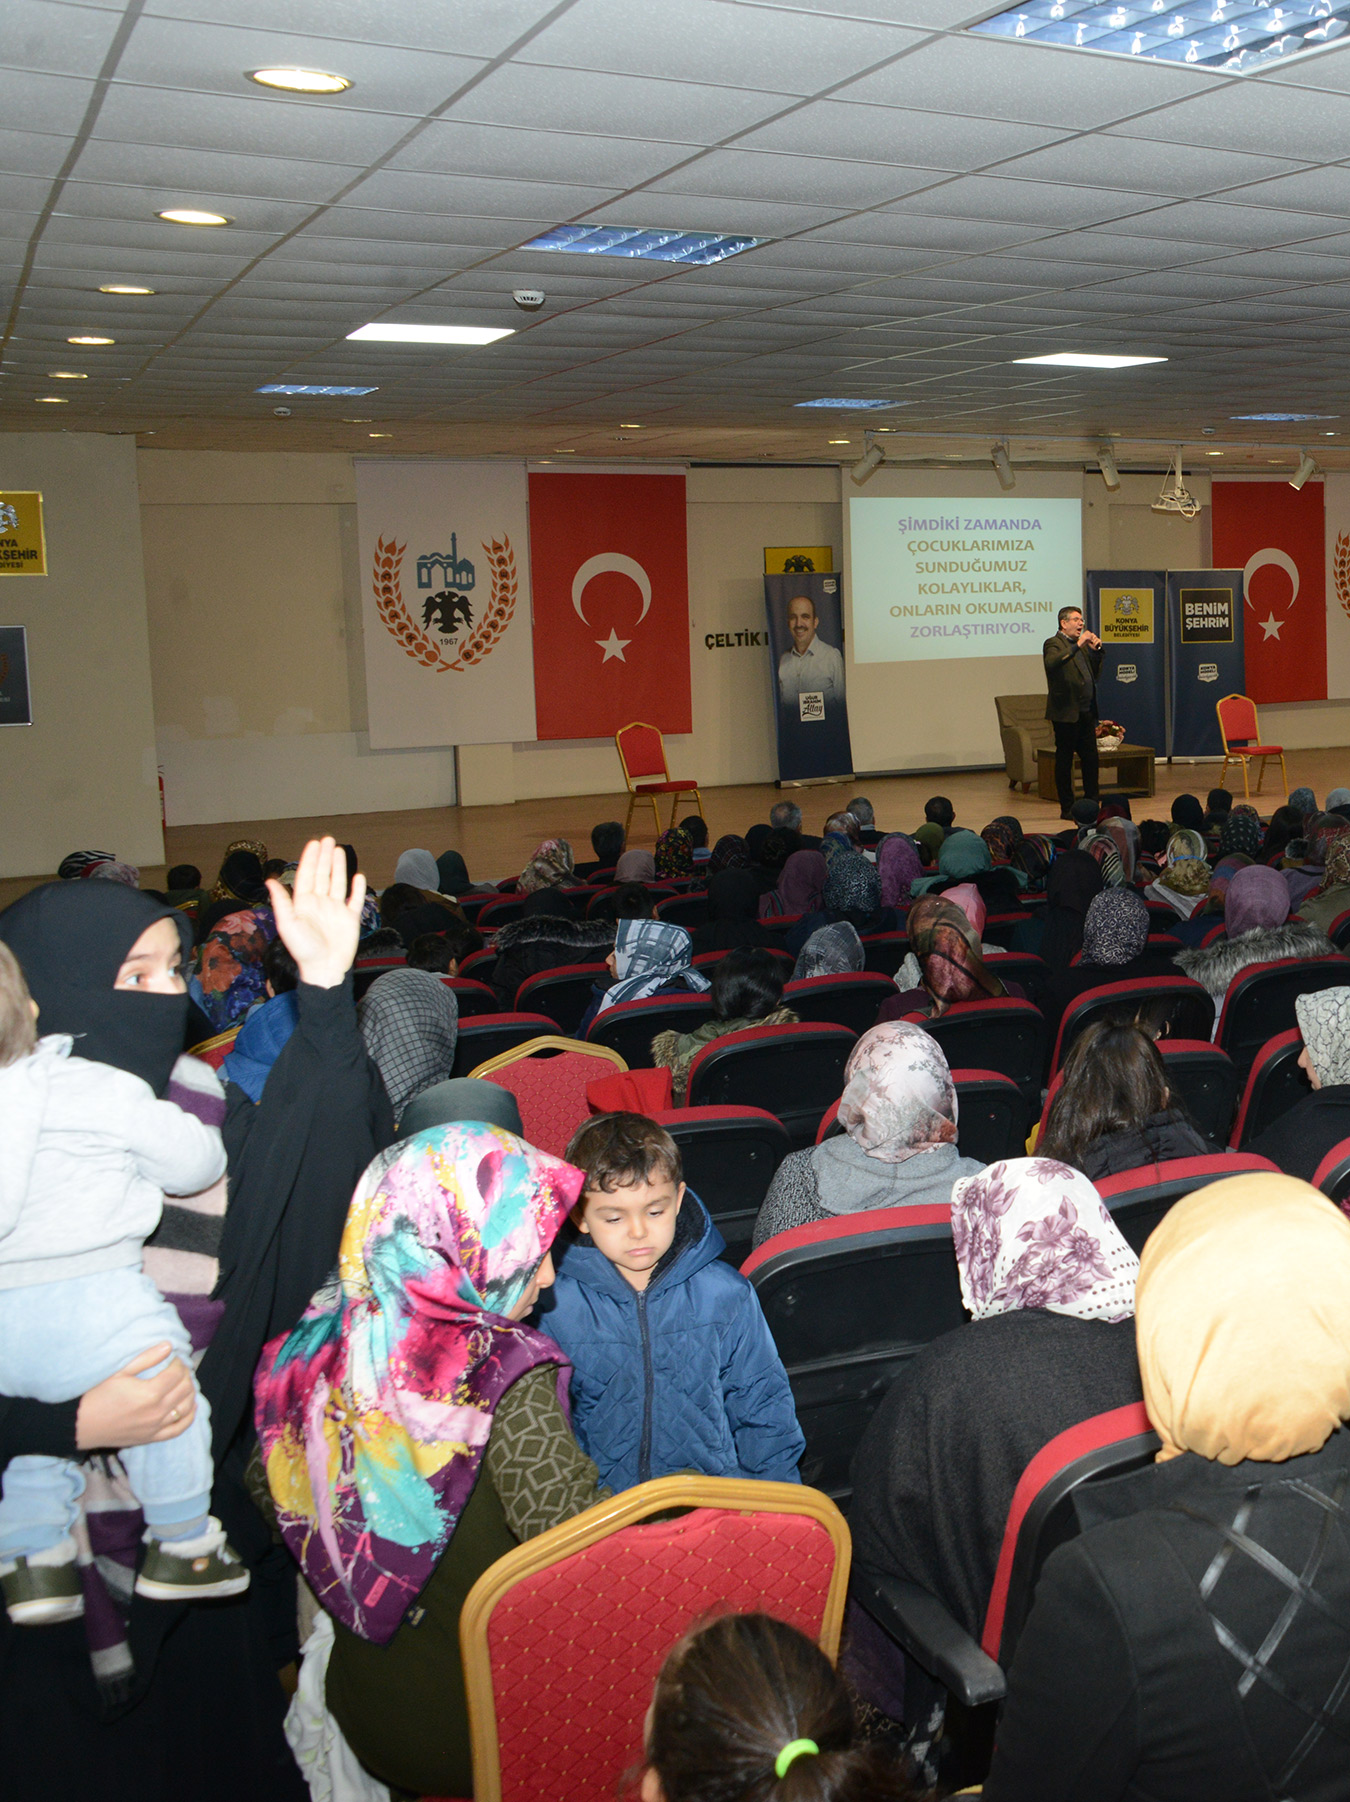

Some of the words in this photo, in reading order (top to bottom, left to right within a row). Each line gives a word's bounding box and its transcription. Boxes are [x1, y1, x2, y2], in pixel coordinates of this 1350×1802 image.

[898, 516, 959, 534] ŞİMDİKİ
[963, 519, 1042, 530] ZAMANDA
[907, 539, 1035, 556] ÇOCUKLARIMIZA
[915, 558, 1028, 574] SUNDUĞUMUZ
[918, 581, 1027, 595] KOLAYLIKLAR,
[889, 603, 961, 617] ONLARIN
[965, 601, 1053, 614] OKUMASINI
[1185, 602, 1229, 616] BENİM
[910, 622, 1035, 639] ZORLAŞTIRIYOR.
[1104, 623, 1149, 632] BÜYÜKŞEHİR
[1185, 617, 1230, 630] ŞEHRİM
[440, 637, 458, 645] 1967
[704, 629, 761, 650] ÇELTİK
